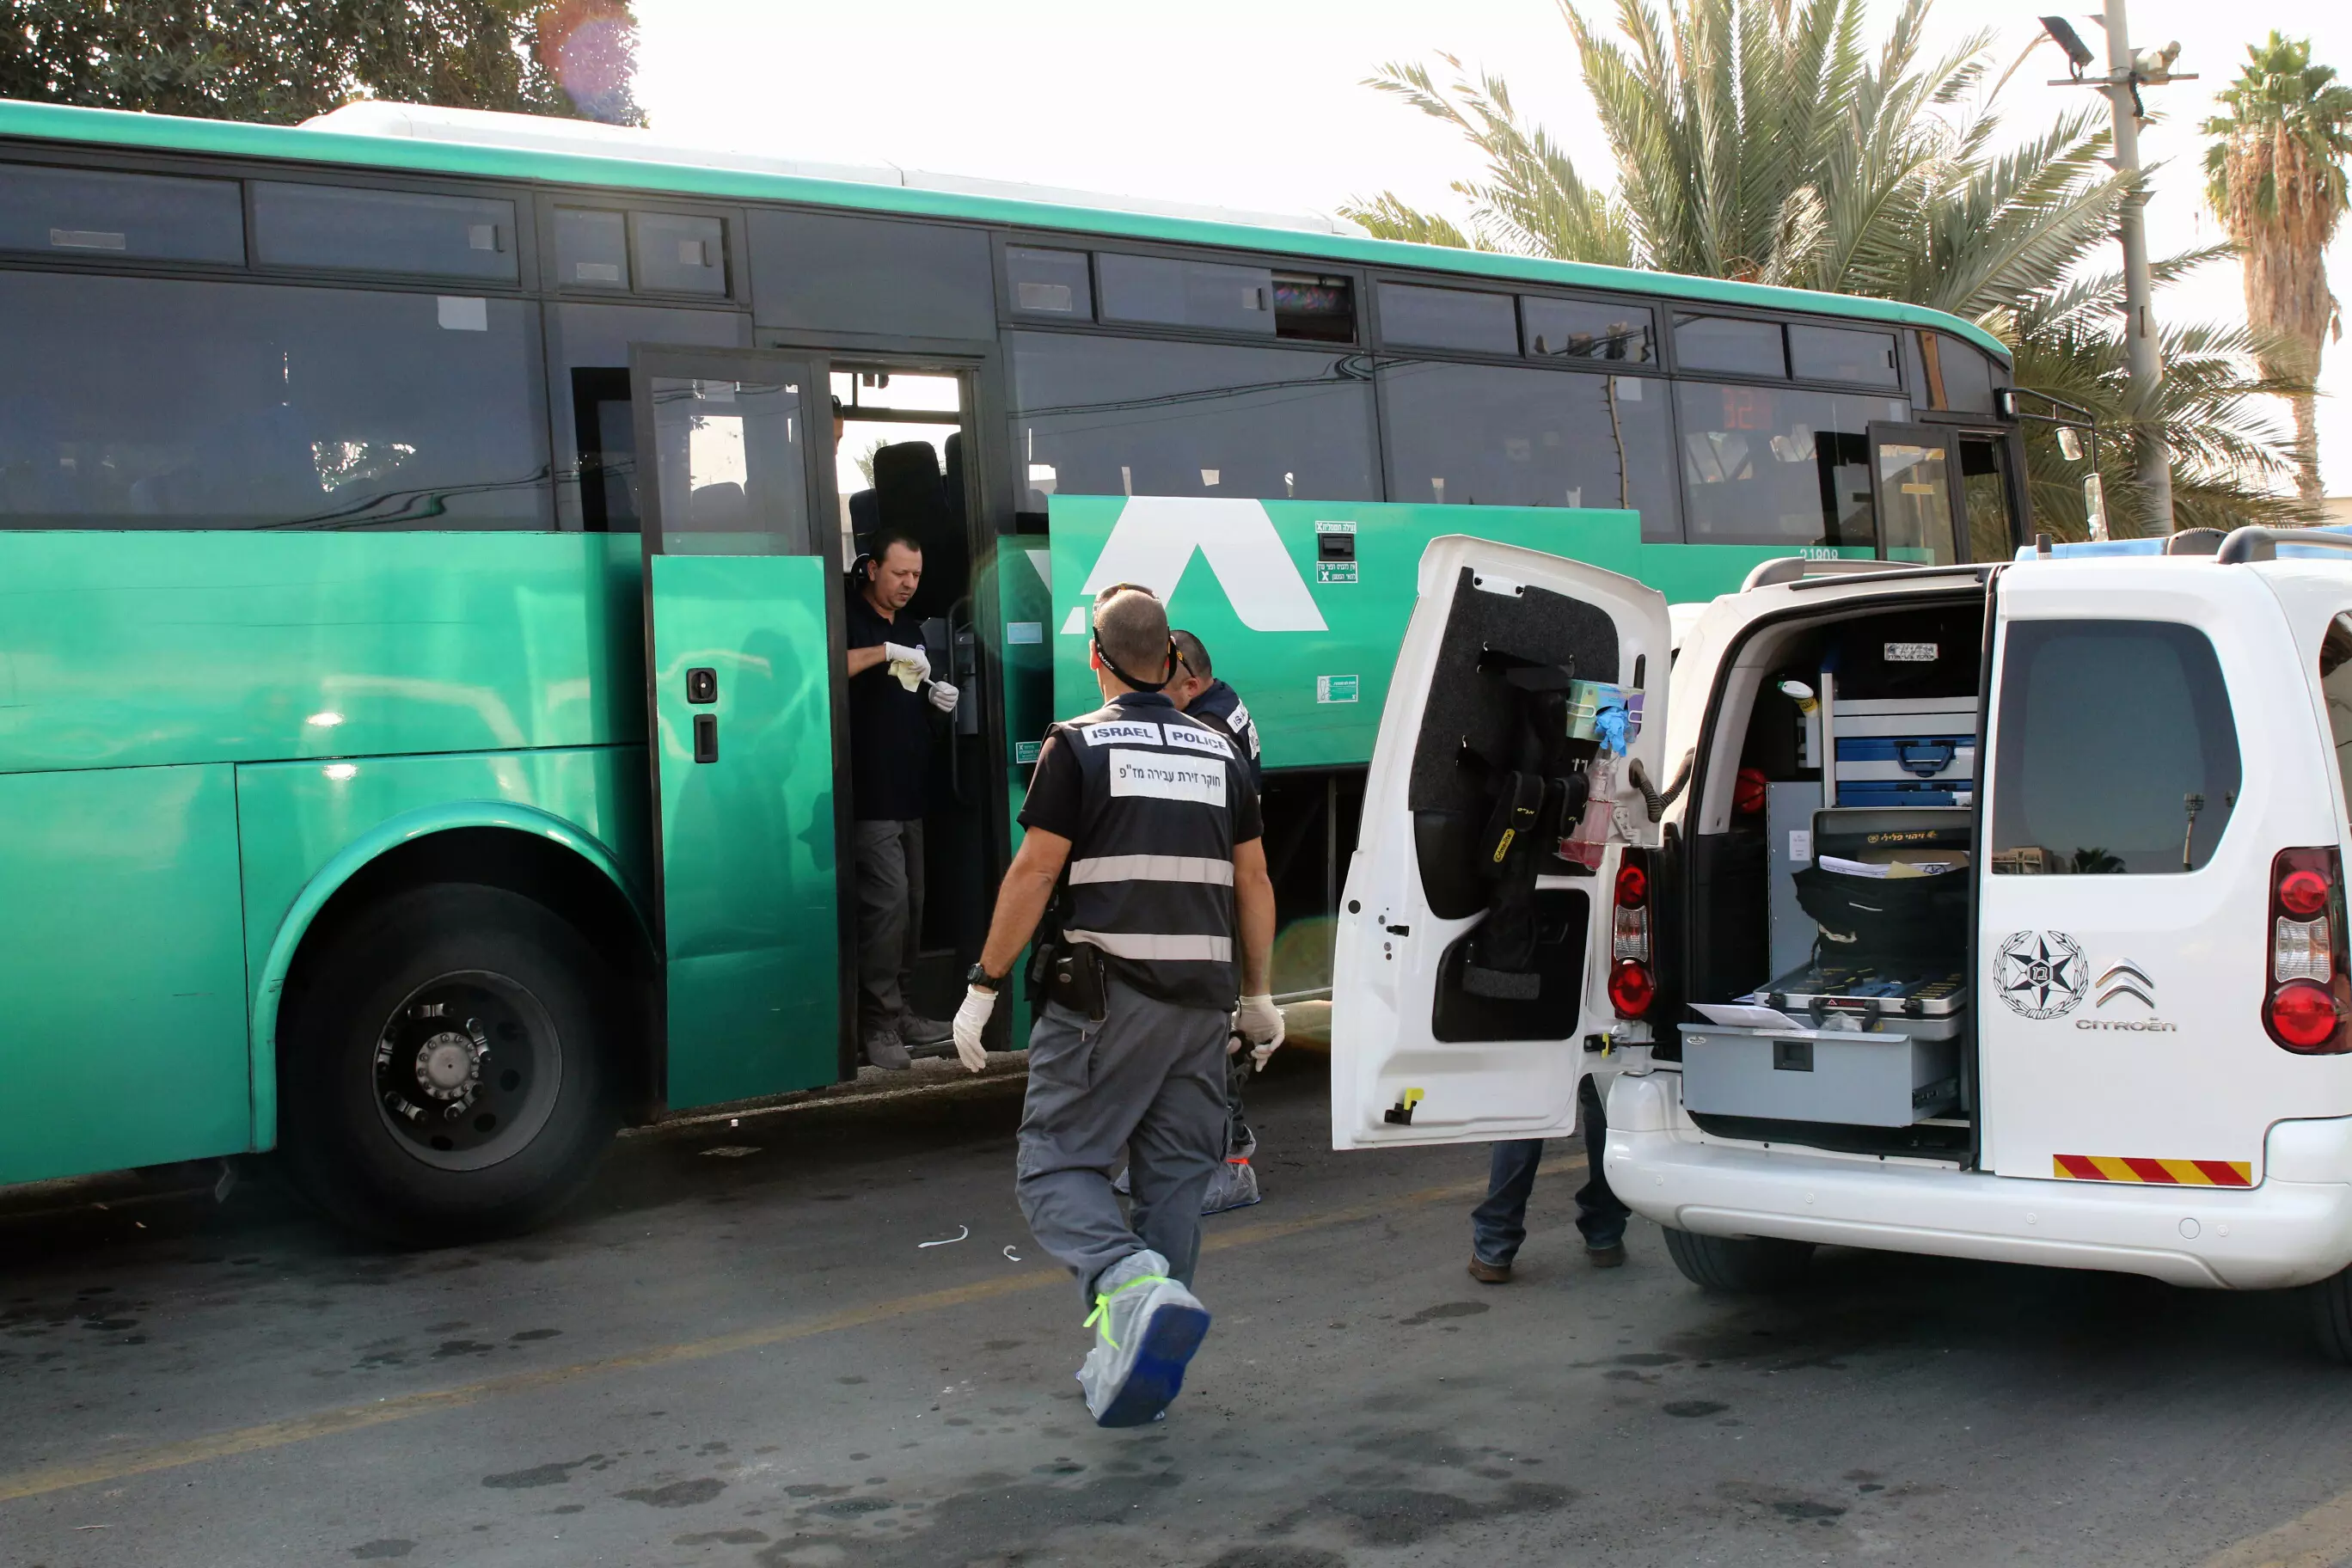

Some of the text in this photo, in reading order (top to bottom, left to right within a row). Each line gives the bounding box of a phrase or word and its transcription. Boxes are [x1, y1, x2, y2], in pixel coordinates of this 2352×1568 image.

[1093, 726, 1228, 750] ISRAEL POLICE
[1119, 764, 1221, 788] חוקר זירת עבירה מז"פ
